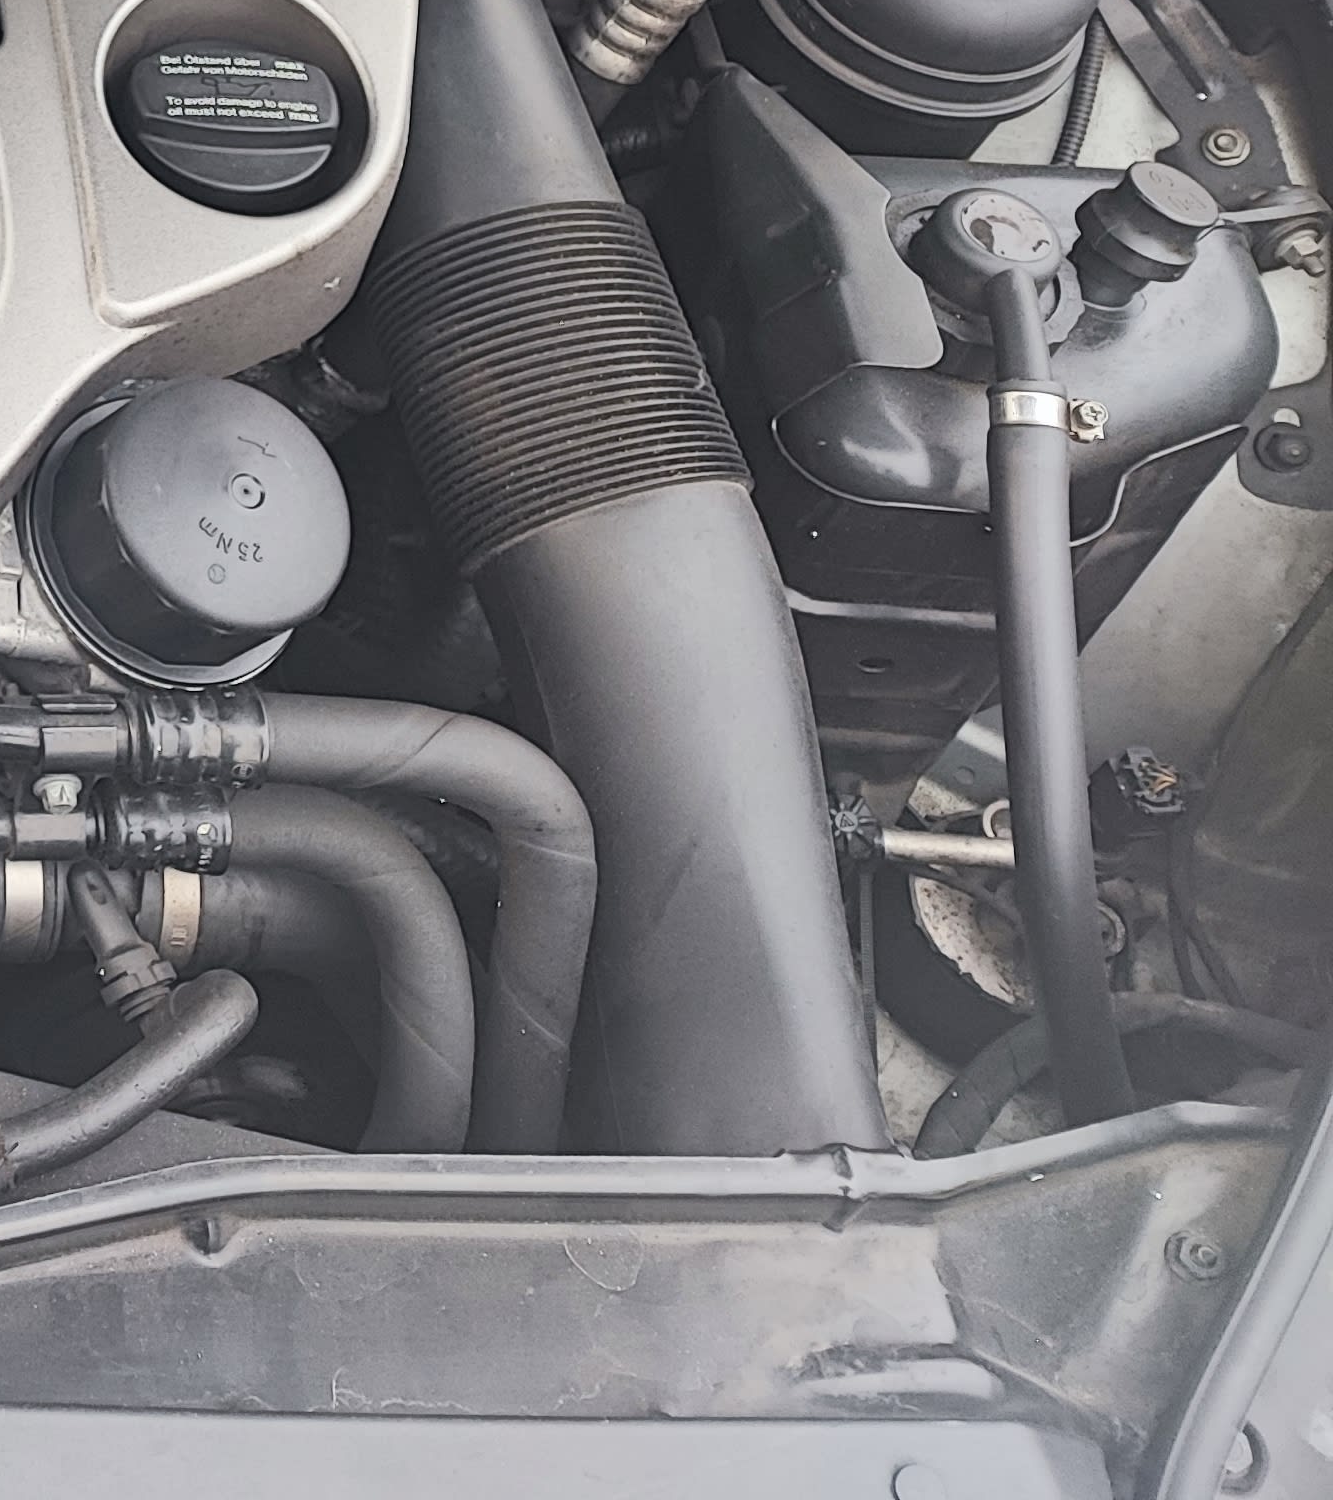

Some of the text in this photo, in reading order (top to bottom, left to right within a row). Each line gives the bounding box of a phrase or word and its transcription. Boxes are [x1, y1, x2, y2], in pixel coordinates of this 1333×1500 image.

[201, 67, 225, 75] von
[165, 96, 318, 112] To avoid damage to engine
[184, 107, 216, 117] must
[216, 107, 238, 117] not
[237, 109, 285, 119] exceed
